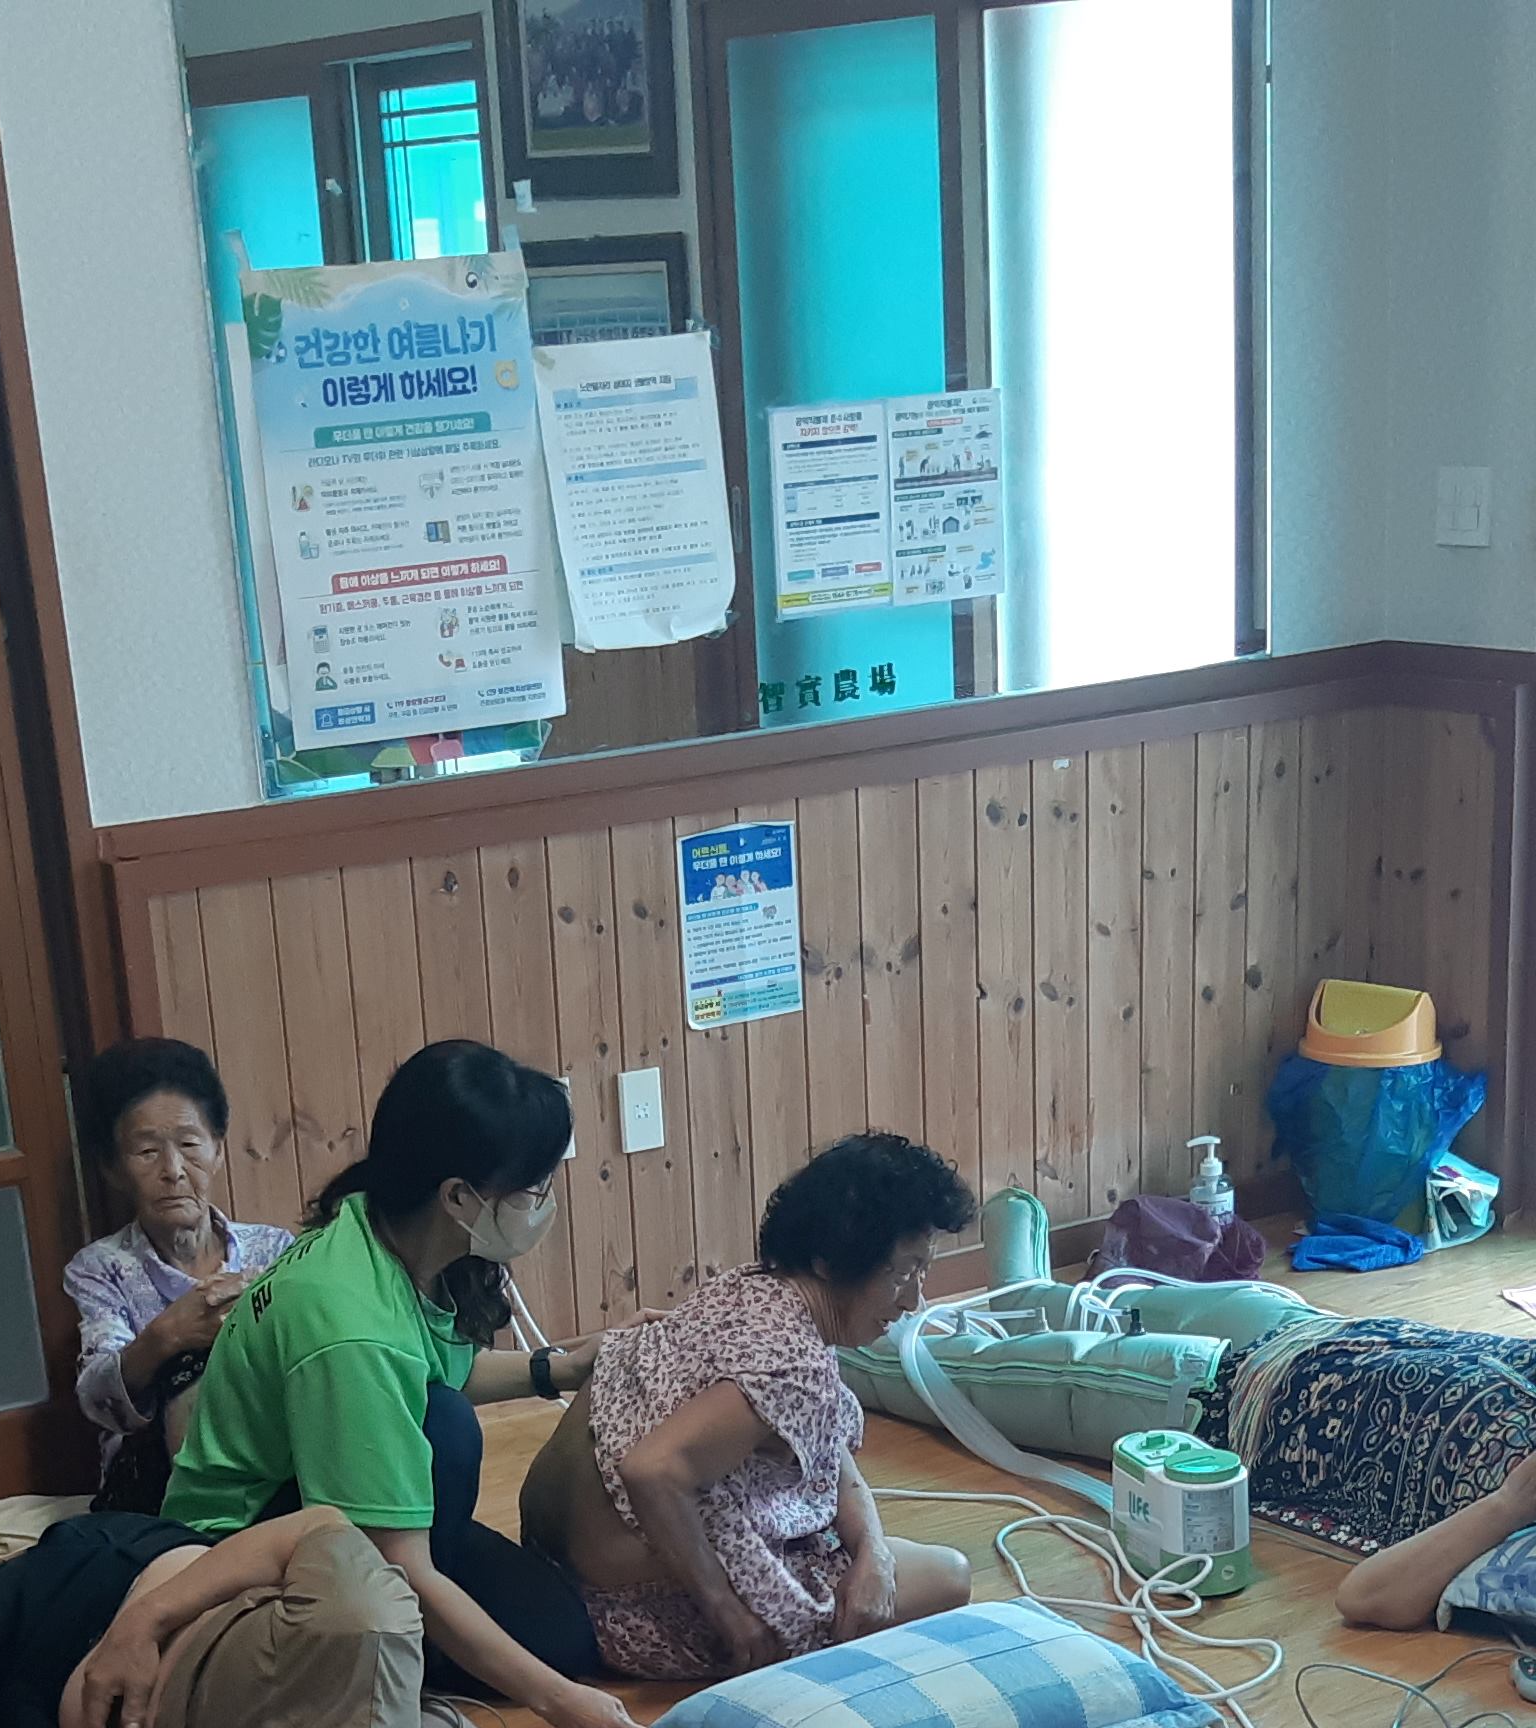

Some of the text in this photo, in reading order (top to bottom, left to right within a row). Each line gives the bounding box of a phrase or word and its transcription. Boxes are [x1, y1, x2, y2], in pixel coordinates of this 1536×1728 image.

[294, 313, 497, 369] 건강한 여름나기
[322, 365, 478, 407] 이렇게 하세요!
[1128, 1490, 1150, 1523] LIFE
